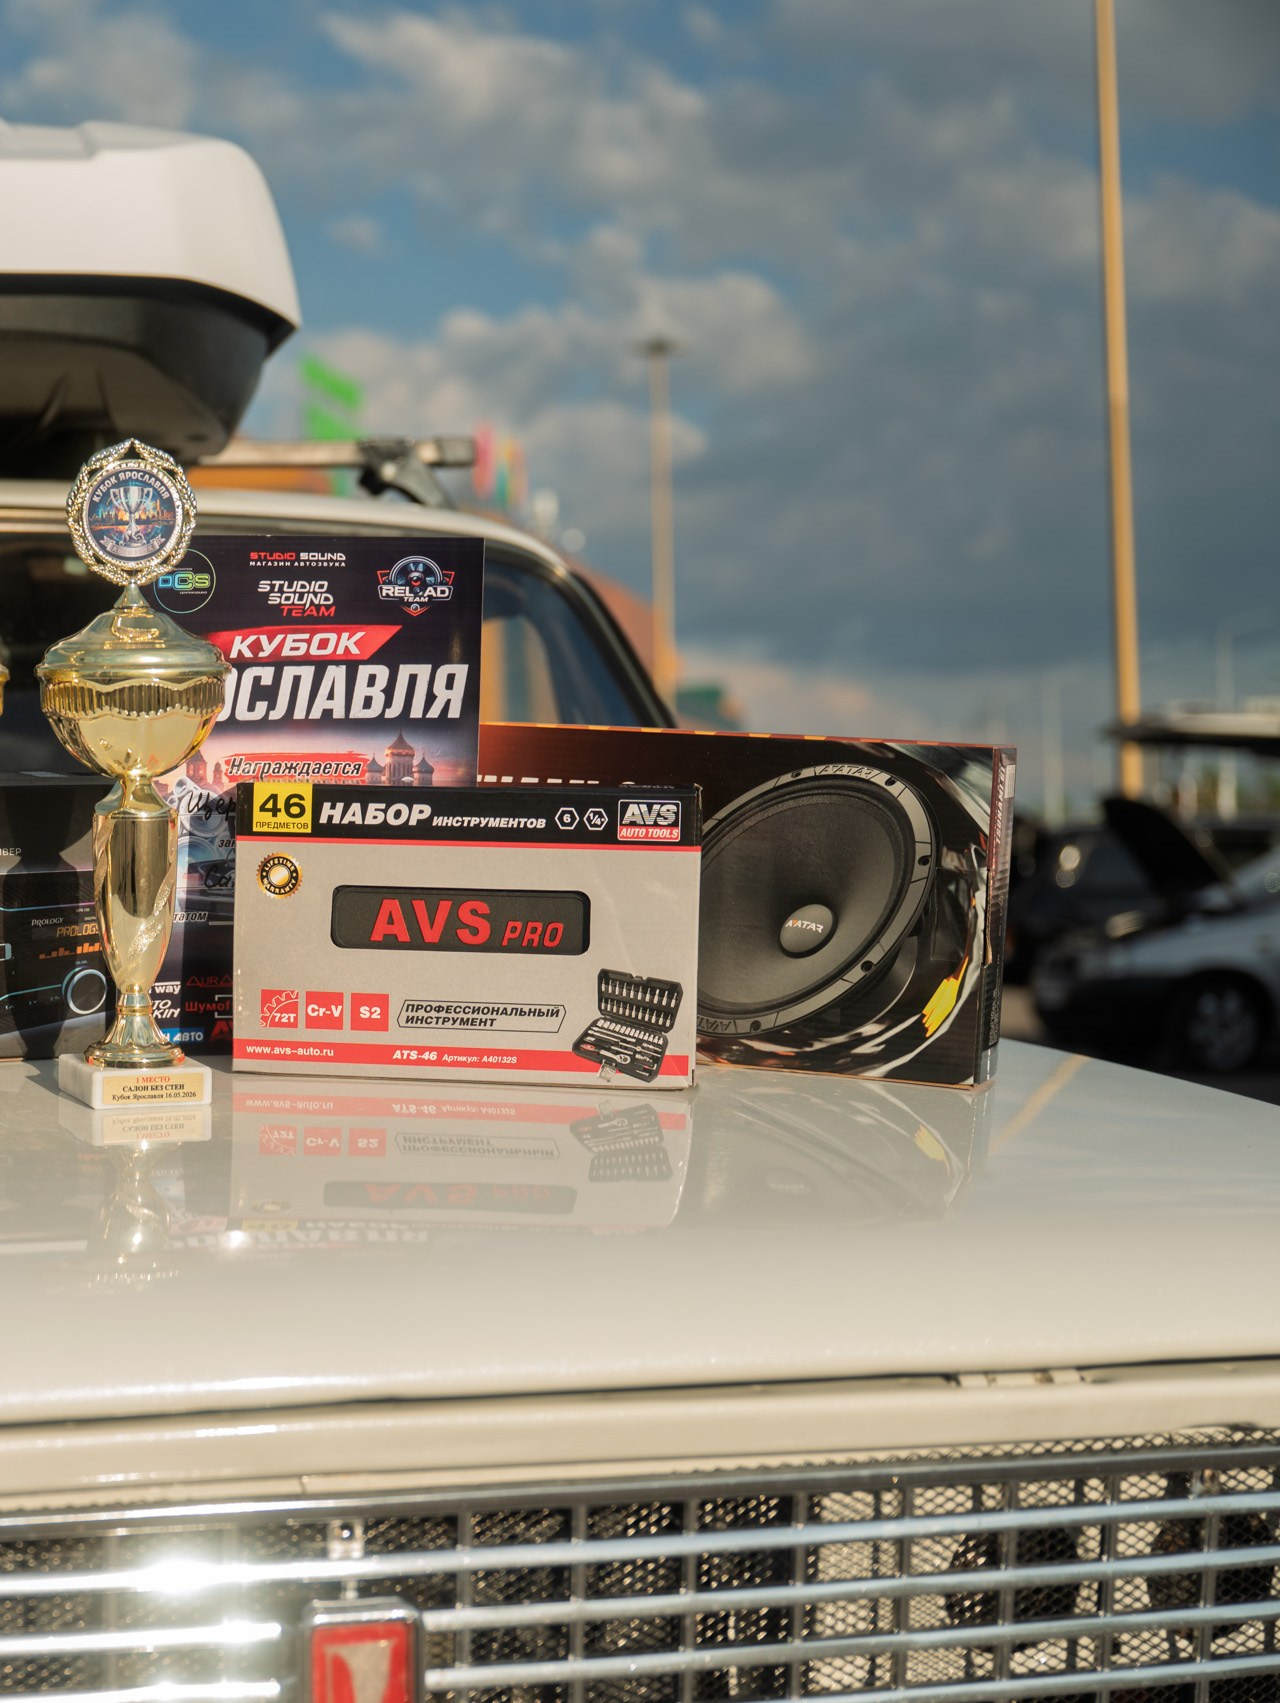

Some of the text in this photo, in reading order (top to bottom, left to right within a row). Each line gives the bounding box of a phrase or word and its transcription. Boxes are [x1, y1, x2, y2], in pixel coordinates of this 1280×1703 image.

[92, 471, 170, 502] КУБОК ЯРОСЛАВЛЯ
[249, 552, 346, 560] STUDIO SOUND
[257, 580, 328, 592] STUDIO
[267, 593, 334, 607] SOUND
[280, 605, 336, 617] TEAM
[229, 631, 366, 659] КУБОК
[228, 756, 363, 780] Награждается
[259, 793, 306, 818] 46
[319, 802, 546, 829] НАБОР ИНСТРУМЕНТОВ
[563, 814, 571, 823] 6
[622, 803, 678, 825] AVS
[255, 821, 309, 830] ПРЕДМЕТОВ
[620, 827, 679, 838] AUTO TOOLS
[31, 917, 64, 926] PROLOGY
[369, 899, 564, 949] AVS PRO
[307, 1004, 342, 1017] Cr-V
[359, 1005, 381, 1019] S2
[405, 1003, 560, 1018] ПРОФЕССИОНАЛЬНЫЙ
[273, 1013, 296, 1022] 72T
[405, 1016, 497, 1027] ИНСТРУМЕНТ
[246, 1046, 334, 1057] www.avs-auto.ru
[392, 1050, 517, 1064] ATS-46 Артикул: A40132S
[112, 1094, 131, 1102] Кубок
[132, 1093, 164, 1101] Ярославля
